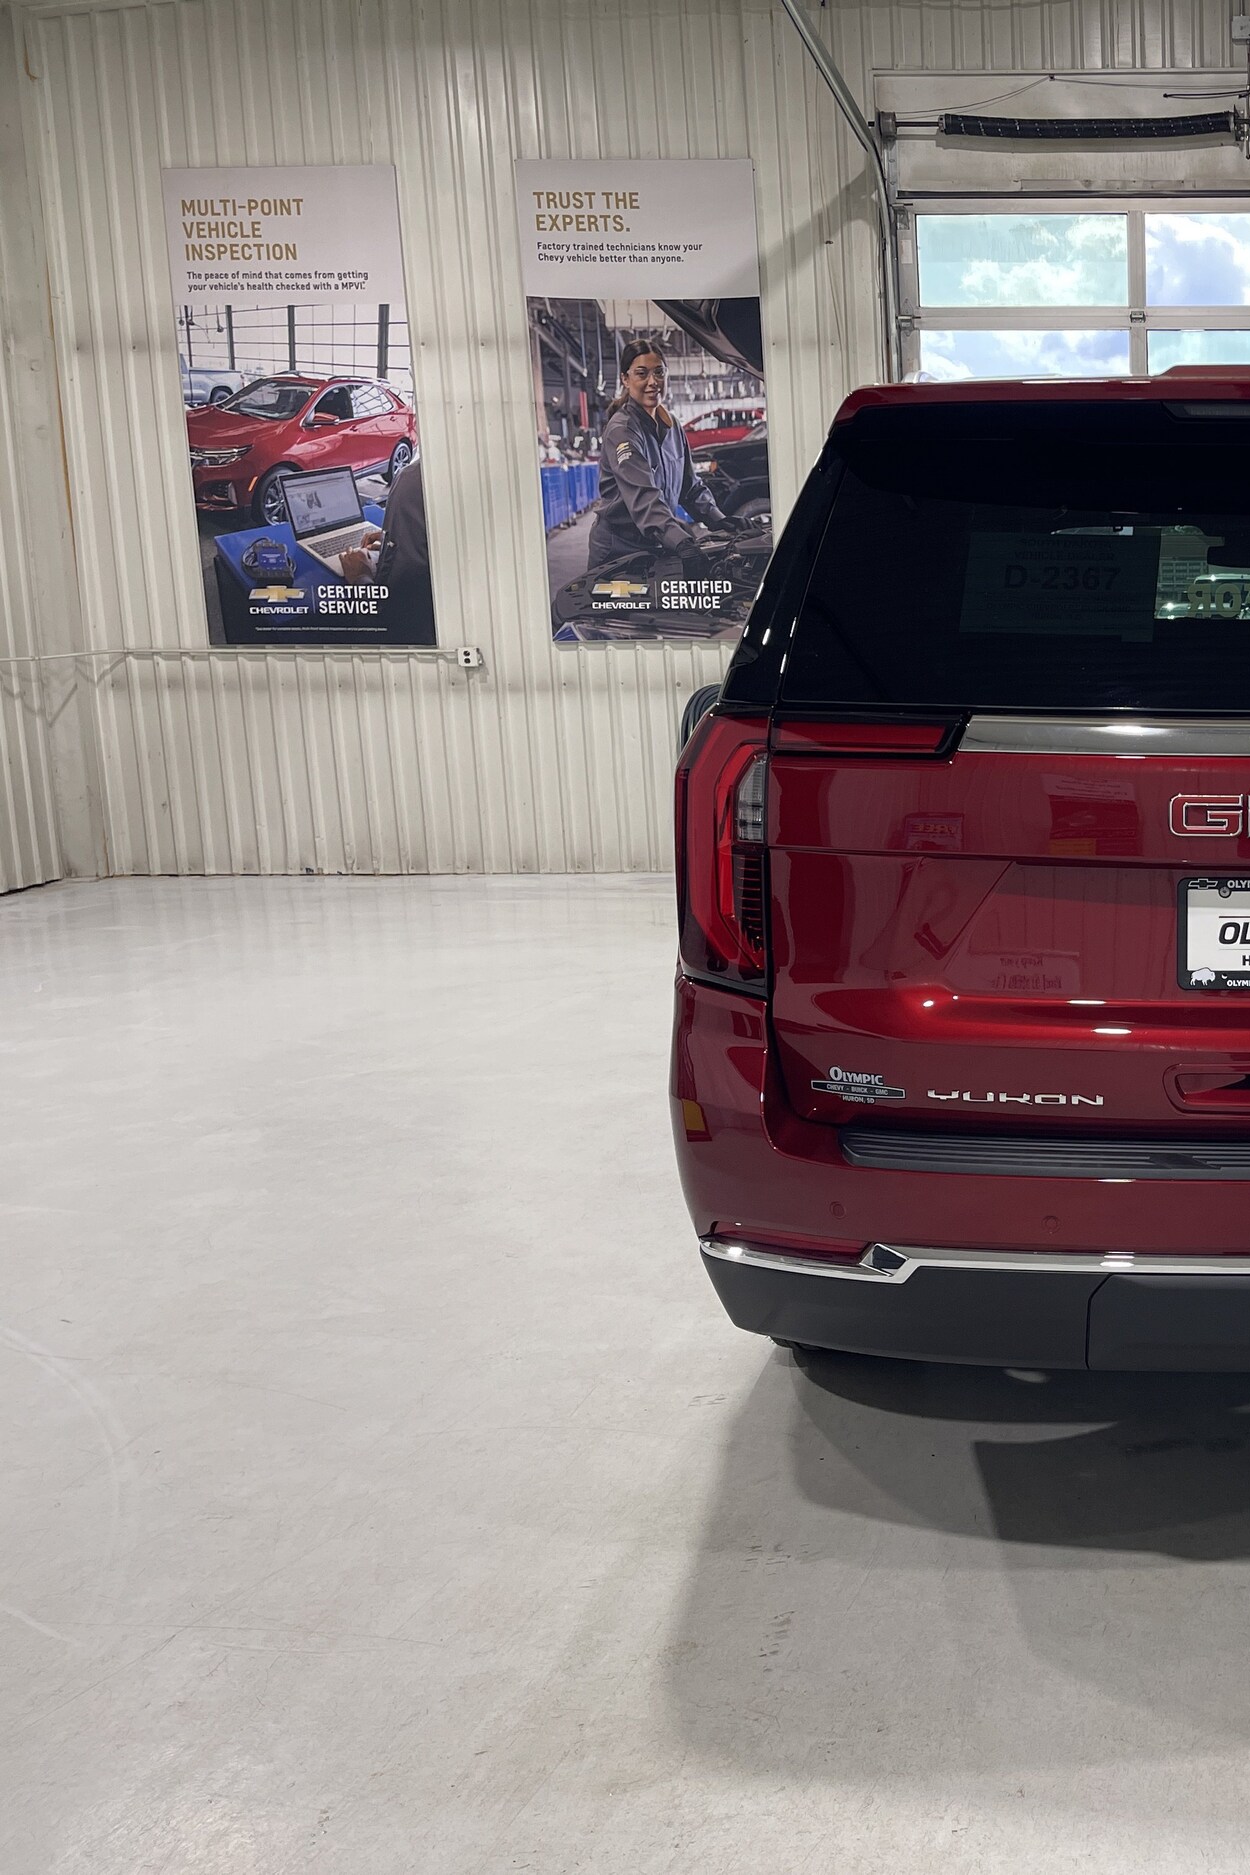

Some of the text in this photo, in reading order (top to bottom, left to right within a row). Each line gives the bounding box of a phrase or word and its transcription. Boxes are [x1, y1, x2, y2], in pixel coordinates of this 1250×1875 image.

[533, 191, 640, 209] TRUST THE
[181, 198, 304, 217] MULTI-POINT
[182, 221, 262, 239] VEHICLE
[535, 214, 630, 232] EXPERTS.
[185, 243, 297, 261] INSPECTION
[537, 242, 703, 252] Factory trained technicians know your
[538, 253, 684, 264] Chevy vehicle better than anyone.
[186, 271, 202, 279] The
[204, 272, 229, 281] peace
[231, 271, 240, 279] of
[242, 271, 263, 279] mind
[264, 271, 283, 279] that
[314, 271, 335, 279] from
[337, 270, 368, 281] getting
[187, 283, 207, 292] your
[208, 281, 245, 290] vehicle's
[246, 281, 274, 290] health
[275, 281, 311, 290] checked
[312, 281, 332, 290] with
[1004, 564, 1122, 591] D-2367
[317, 585, 389, 599] CERTIFIED
[661, 580, 732, 594] CERTIFIED
[319, 600, 378, 614] SERVICE
[592, 601, 651, 609] CHEVROLET
[661, 596, 720, 609] SERVICE
[249, 606, 309, 614] CHEVROLET
[829, 1066, 884, 1086] OLYMPIC
[826, 1083, 845, 1091] CHEVY
[842, 1094, 865, 1103] HURON,
[927, 1090, 1104, 1106] YUKON
